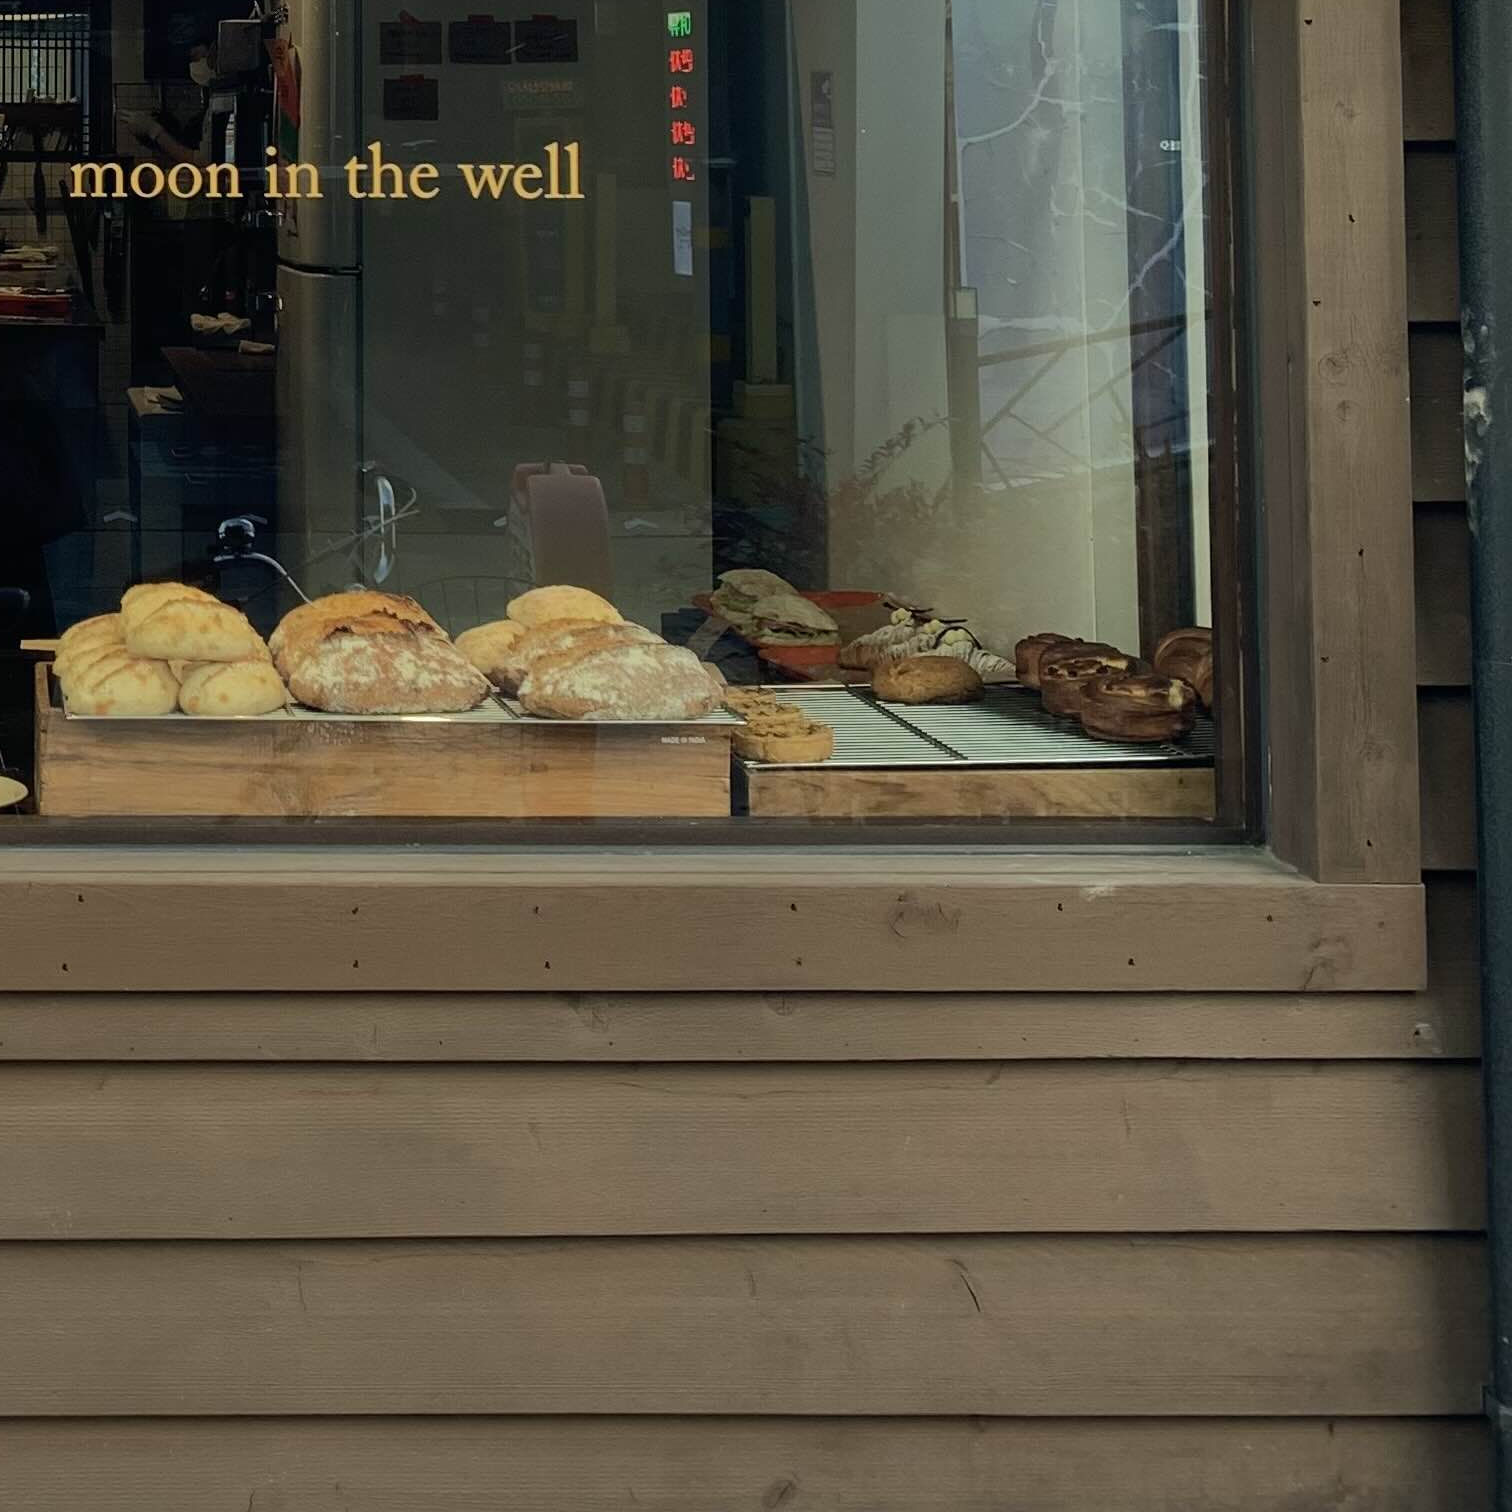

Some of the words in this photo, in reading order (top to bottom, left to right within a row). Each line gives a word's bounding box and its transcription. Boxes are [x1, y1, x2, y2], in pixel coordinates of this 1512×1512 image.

[69, 162, 243, 199] moon
[265, 145, 323, 199] in
[344, 140, 440, 200] the
[457, 141, 585, 200] well
